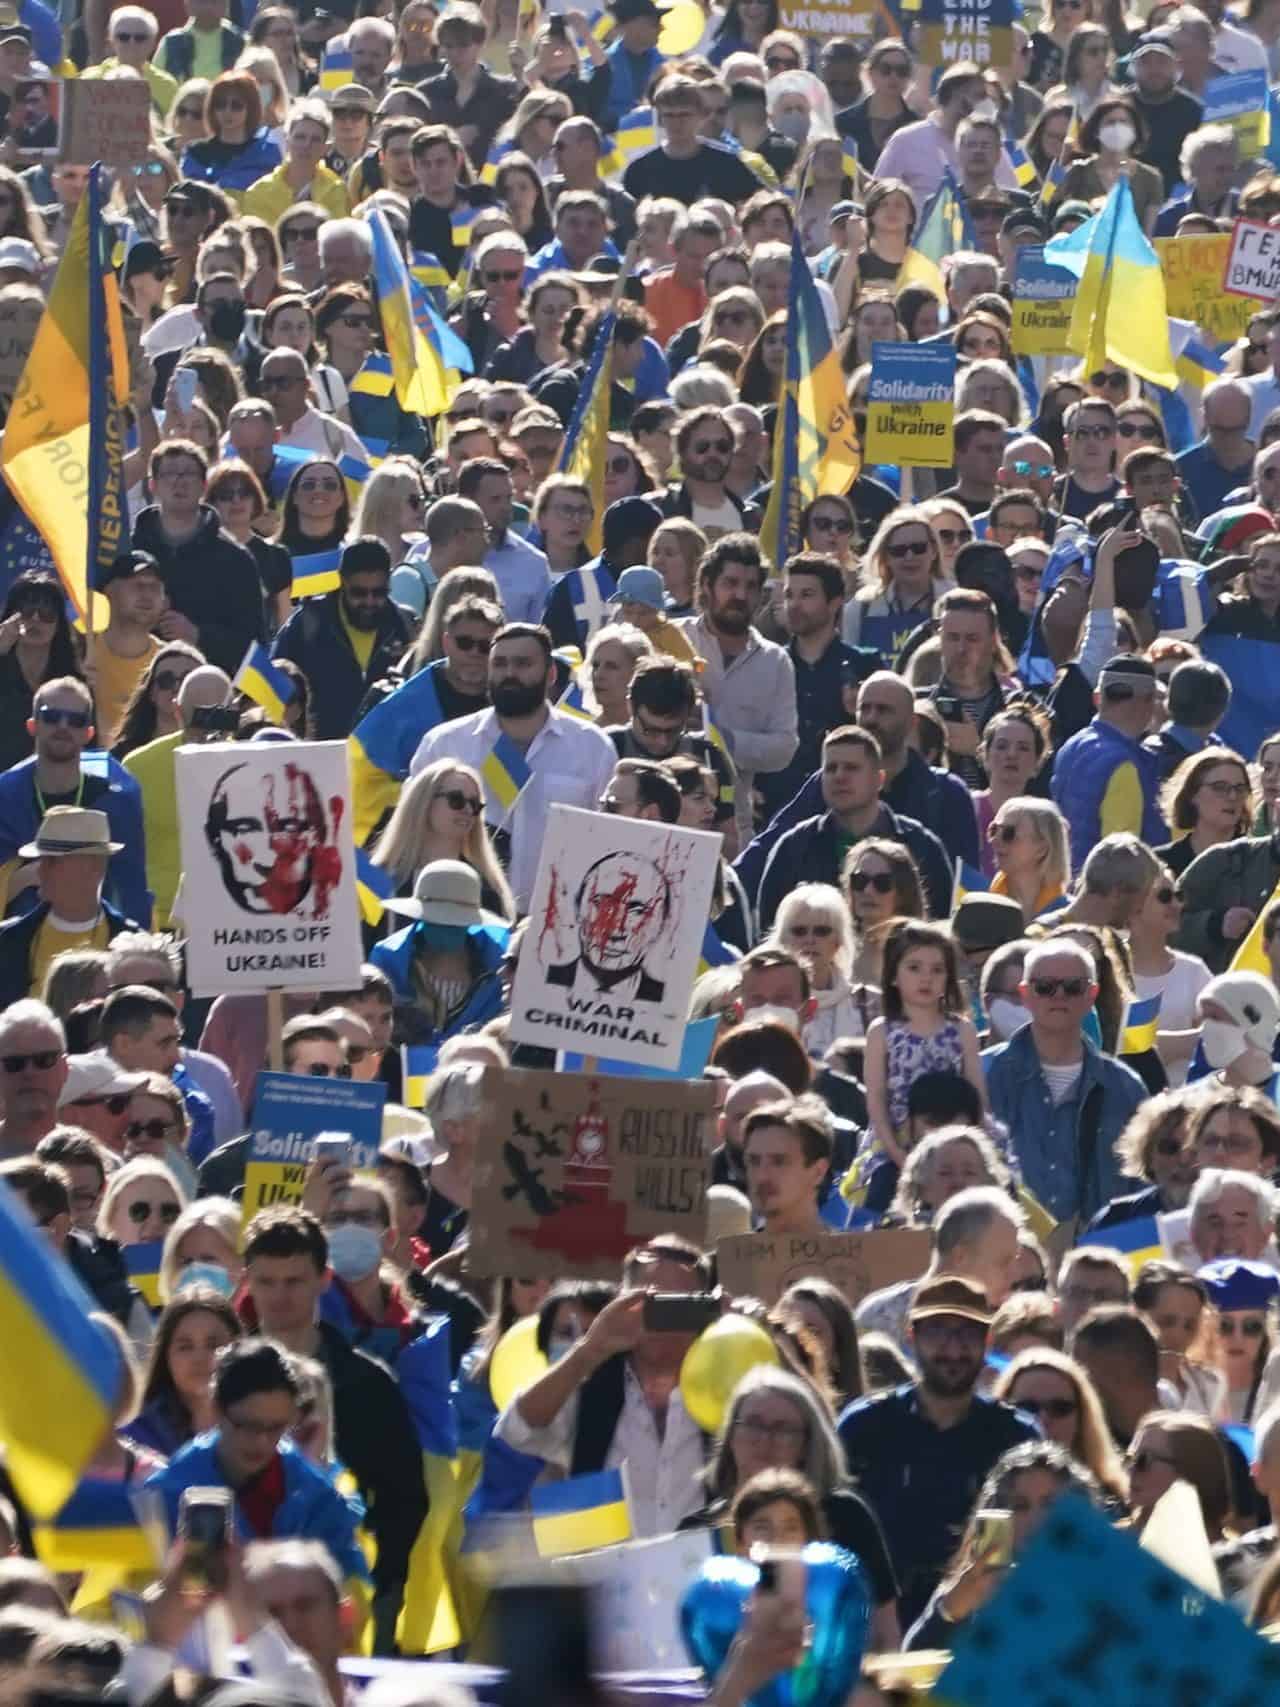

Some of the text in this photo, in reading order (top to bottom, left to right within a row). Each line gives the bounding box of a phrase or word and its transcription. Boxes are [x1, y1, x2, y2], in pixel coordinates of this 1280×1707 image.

[943, 14, 990, 36] THE
[941, 40, 992, 62] WAR
[1014, 278, 1076, 297] Solidari
[870, 378, 954, 402] Solidarity
[890, 402, 923, 417] with
[876, 415, 945, 436] Ukraine
[213, 926, 331, 945] HANDS OFF
[226, 952, 326, 972] UKRAINE!
[566, 996, 635, 1022] WAR
[524, 1008, 668, 1047] CRIMINAL
[254, 1129, 378, 1167] Solidty
